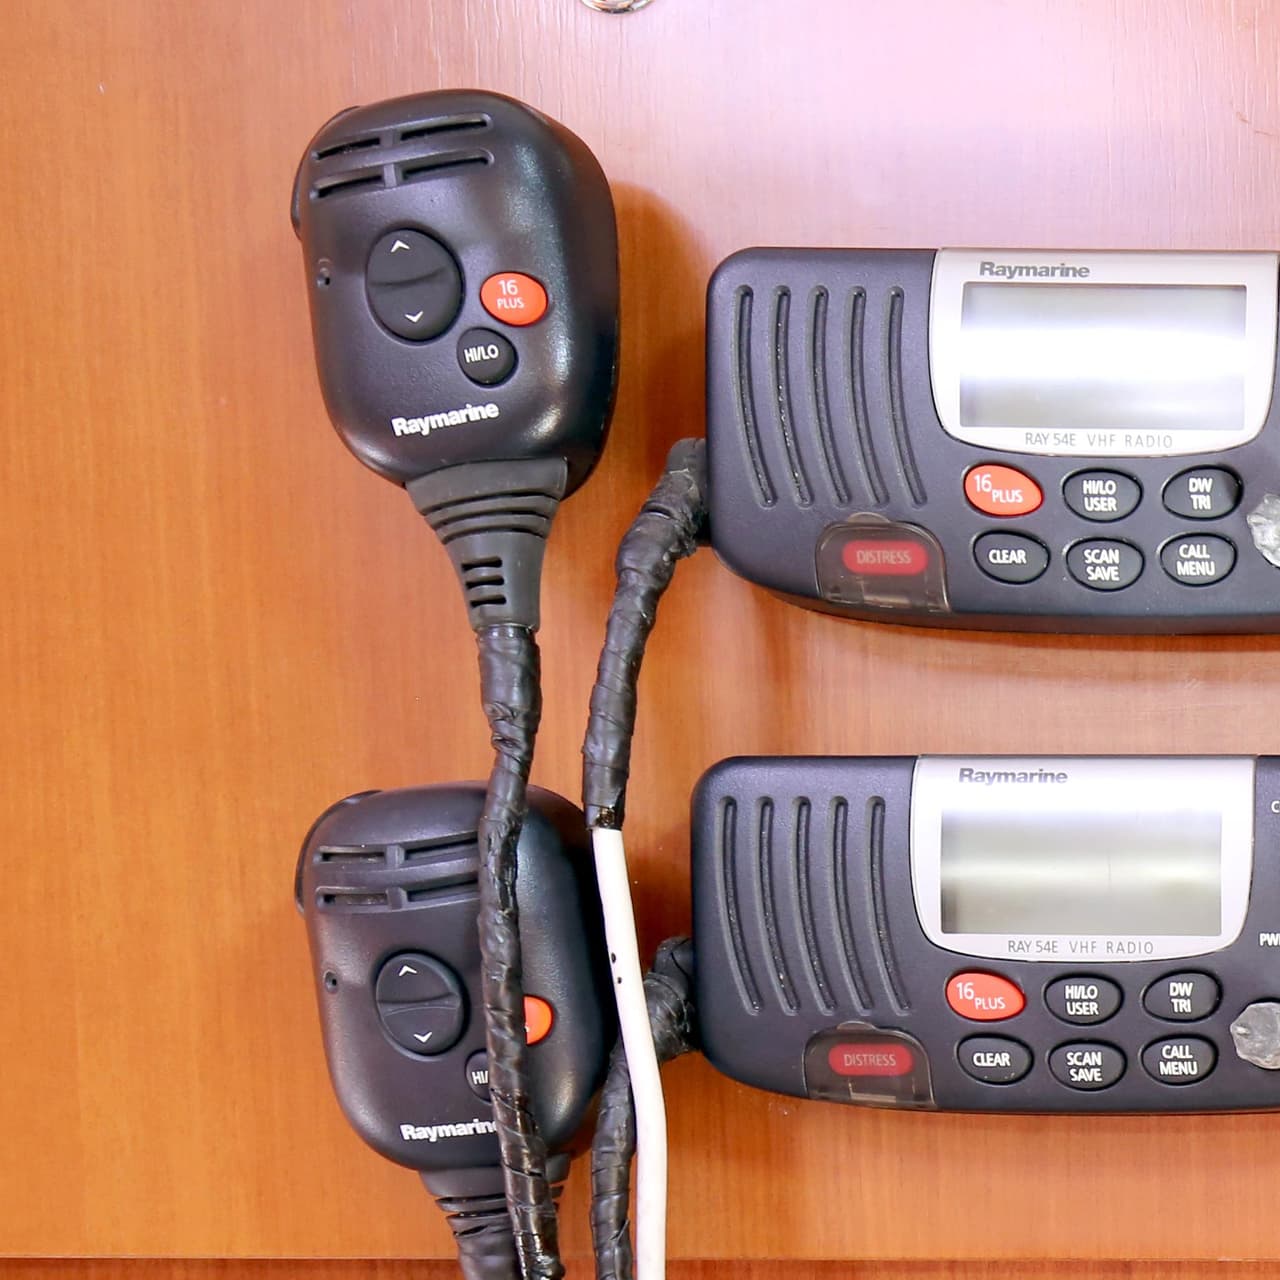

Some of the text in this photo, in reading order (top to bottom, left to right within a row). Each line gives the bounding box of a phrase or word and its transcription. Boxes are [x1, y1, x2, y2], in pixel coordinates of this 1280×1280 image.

[979, 261, 1090, 279] Raymarine
[498, 279, 518, 295] 16
[496, 297, 525, 310] PLUS
[464, 343, 499, 363] HI/LO
[391, 402, 499, 438] Raymarine
[1025, 433, 1173, 448] RAY 54E VHF RADIO
[974, 474, 1023, 504] 16 PLUS
[1082, 480, 1117, 495] HI/LO
[1189, 478, 1213, 494] DW
[1084, 496, 1118, 512] USER
[1190, 495, 1211, 510] TRI
[856, 549, 912, 565] DISTRESS
[989, 549, 1027, 564] CLEAR
[1084, 549, 1120, 564] SCAN
[1178, 544, 1210, 559] CALL
[1086, 566, 1120, 582] SAVE
[1177, 561, 1216, 577] MENU
[959, 767, 1068, 786] Raymarine
[1008, 939, 1154, 955] RAY 54E VHF RADIO
[956, 982, 1006, 1010] 16 PLUS
[1065, 985, 1098, 1000] HI/LO
[1169, 982, 1193, 997] DW
[1066, 1001, 1100, 1016] USER
[1171, 998, 1192, 1013] TRI
[972, 1052, 1011, 1068] CLEAR
[1066, 1051, 1102, 1066] SCAN
[1162, 1045, 1193, 1060] CALL
[843, 1054, 897, 1067] DISTRESS
[1069, 1067, 1102, 1082] SAVE
[1159, 1061, 1198, 1076] MENU
